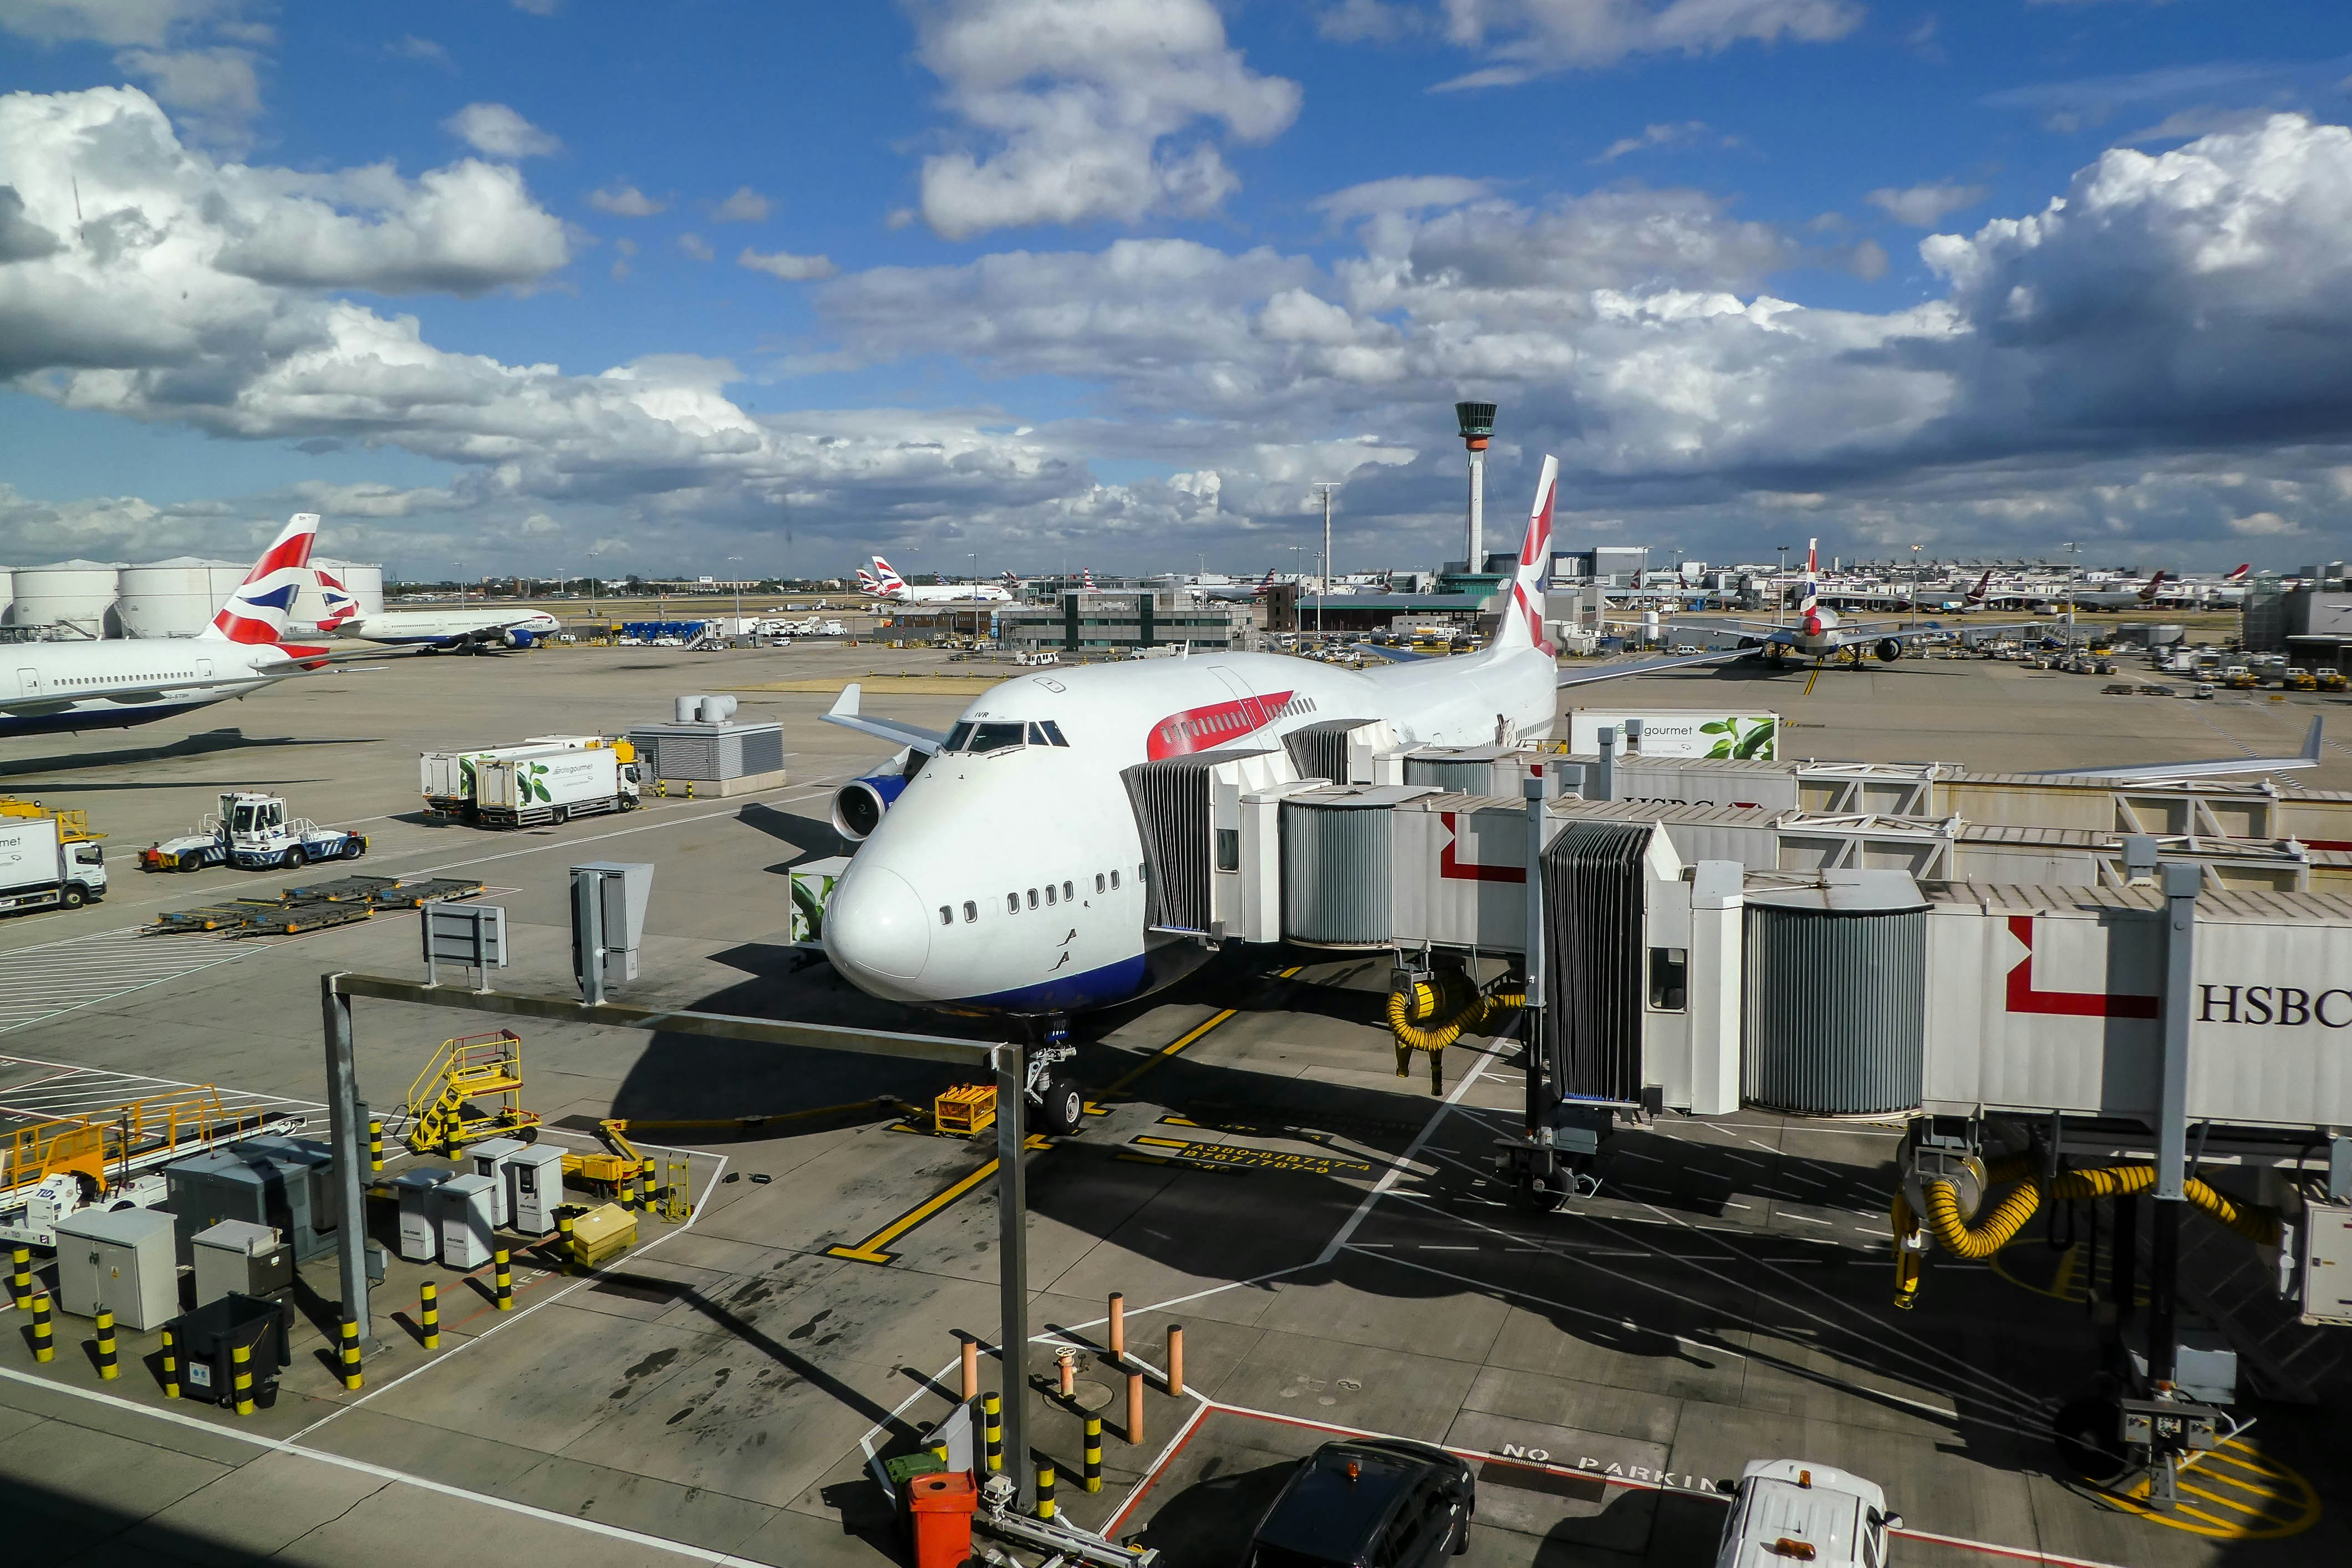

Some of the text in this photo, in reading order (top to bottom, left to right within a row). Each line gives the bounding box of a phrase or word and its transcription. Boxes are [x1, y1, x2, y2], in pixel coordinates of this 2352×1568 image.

[2196, 984, 2352, 1029] HSBC
[35, 1188, 54, 1198] TLD
[1503, 1443, 1550, 1462] NO
